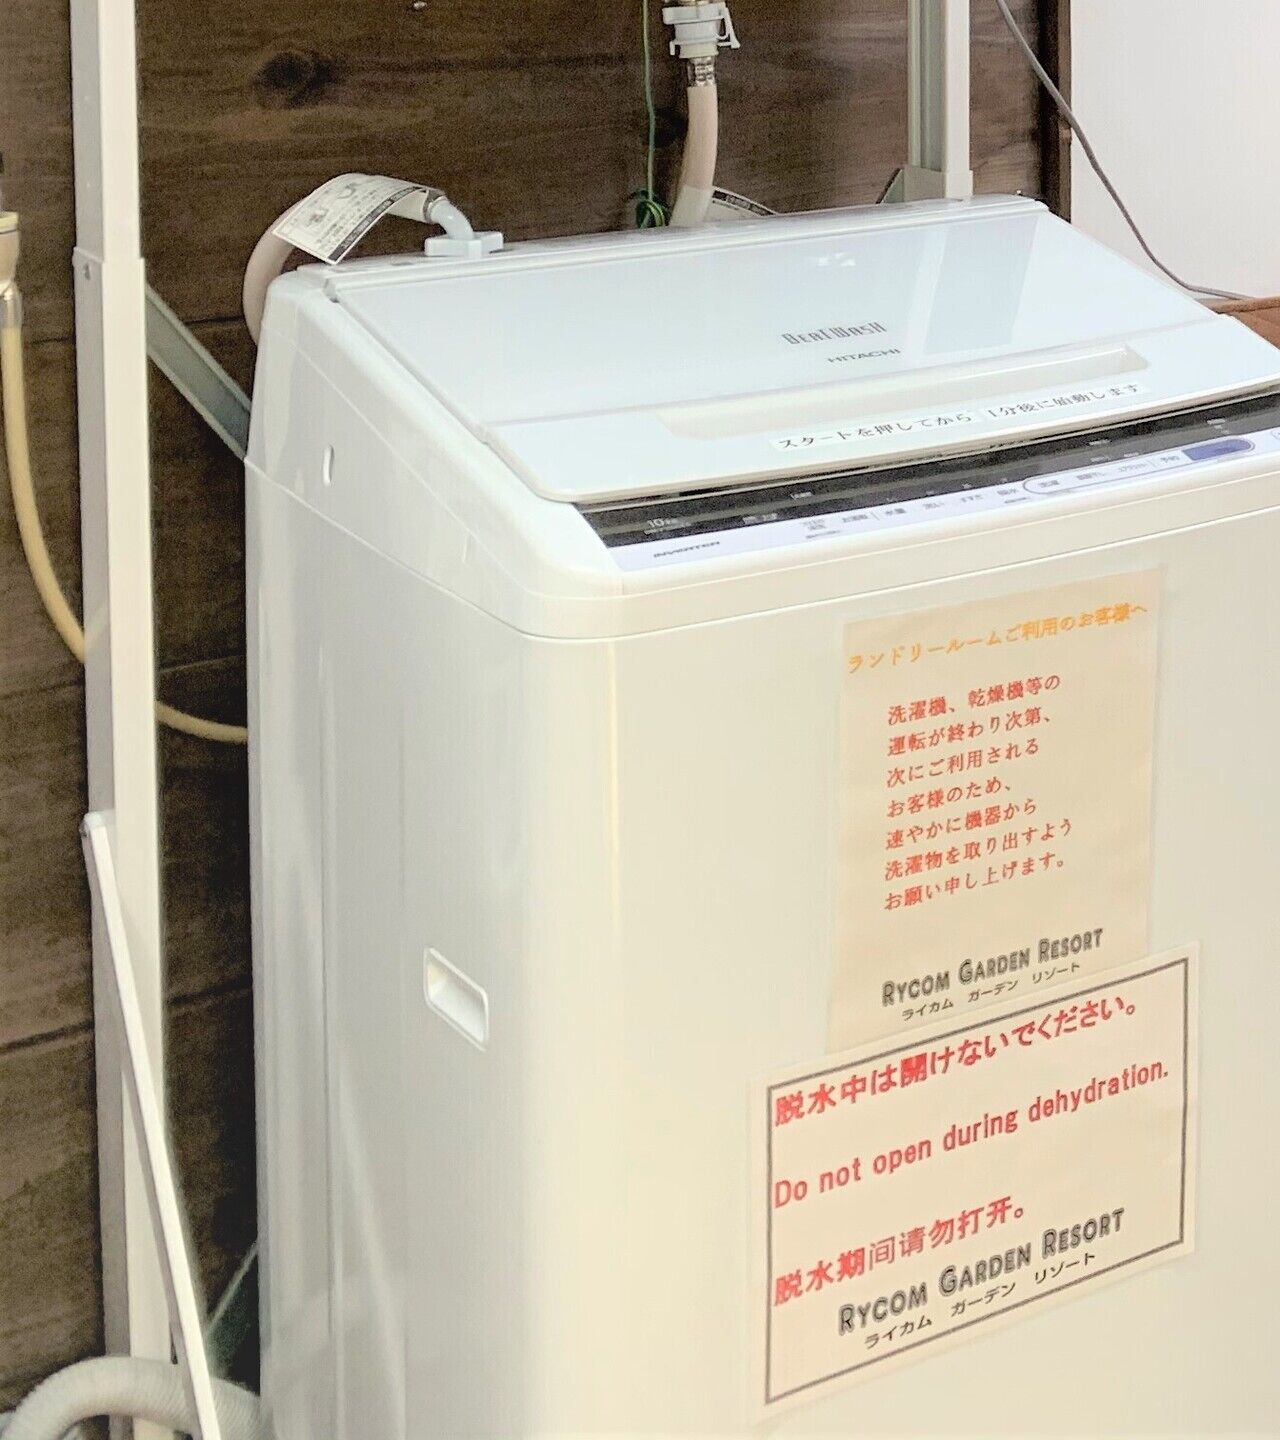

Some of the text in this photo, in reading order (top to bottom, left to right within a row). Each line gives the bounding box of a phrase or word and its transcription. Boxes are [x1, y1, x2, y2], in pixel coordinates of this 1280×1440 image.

[826, 348, 901, 364] HITACHI
[778, 409, 973, 450] スタートを押してから
[849, 602, 1148, 674] ランドリールームご利用のお客様へ
[887, 674, 1061, 726] 洗濯機、乾燥機等の
[887, 706, 1051, 757] 運転が終わり次第、
[886, 737, 1039, 788] 次にご利用される
[885, 798, 1037, 850] 速やかに機器から
[886, 776, 1011, 818] お客様のため、
[884, 818, 1073, 881] 洗濯物を取り出すよう
[884, 852, 1064, 910] お願い申し上げます。
[881, 927, 1104, 1008] RYCOM GARDEN RESORT
[901, 962, 1081, 1022] ライカム ガーデン リゾート
[774, 995, 1136, 1127] 脱水中は開けないでください。
[774, 1059, 1170, 1209] Do not open during dehydration.
[773, 1195, 1025, 1307] 脱水期间请勿打开。
[837, 1207, 1126, 1337] RYCOM GARDEN RESORT
[863, 1251, 1097, 1350] ライカム ガーデン リゾート
